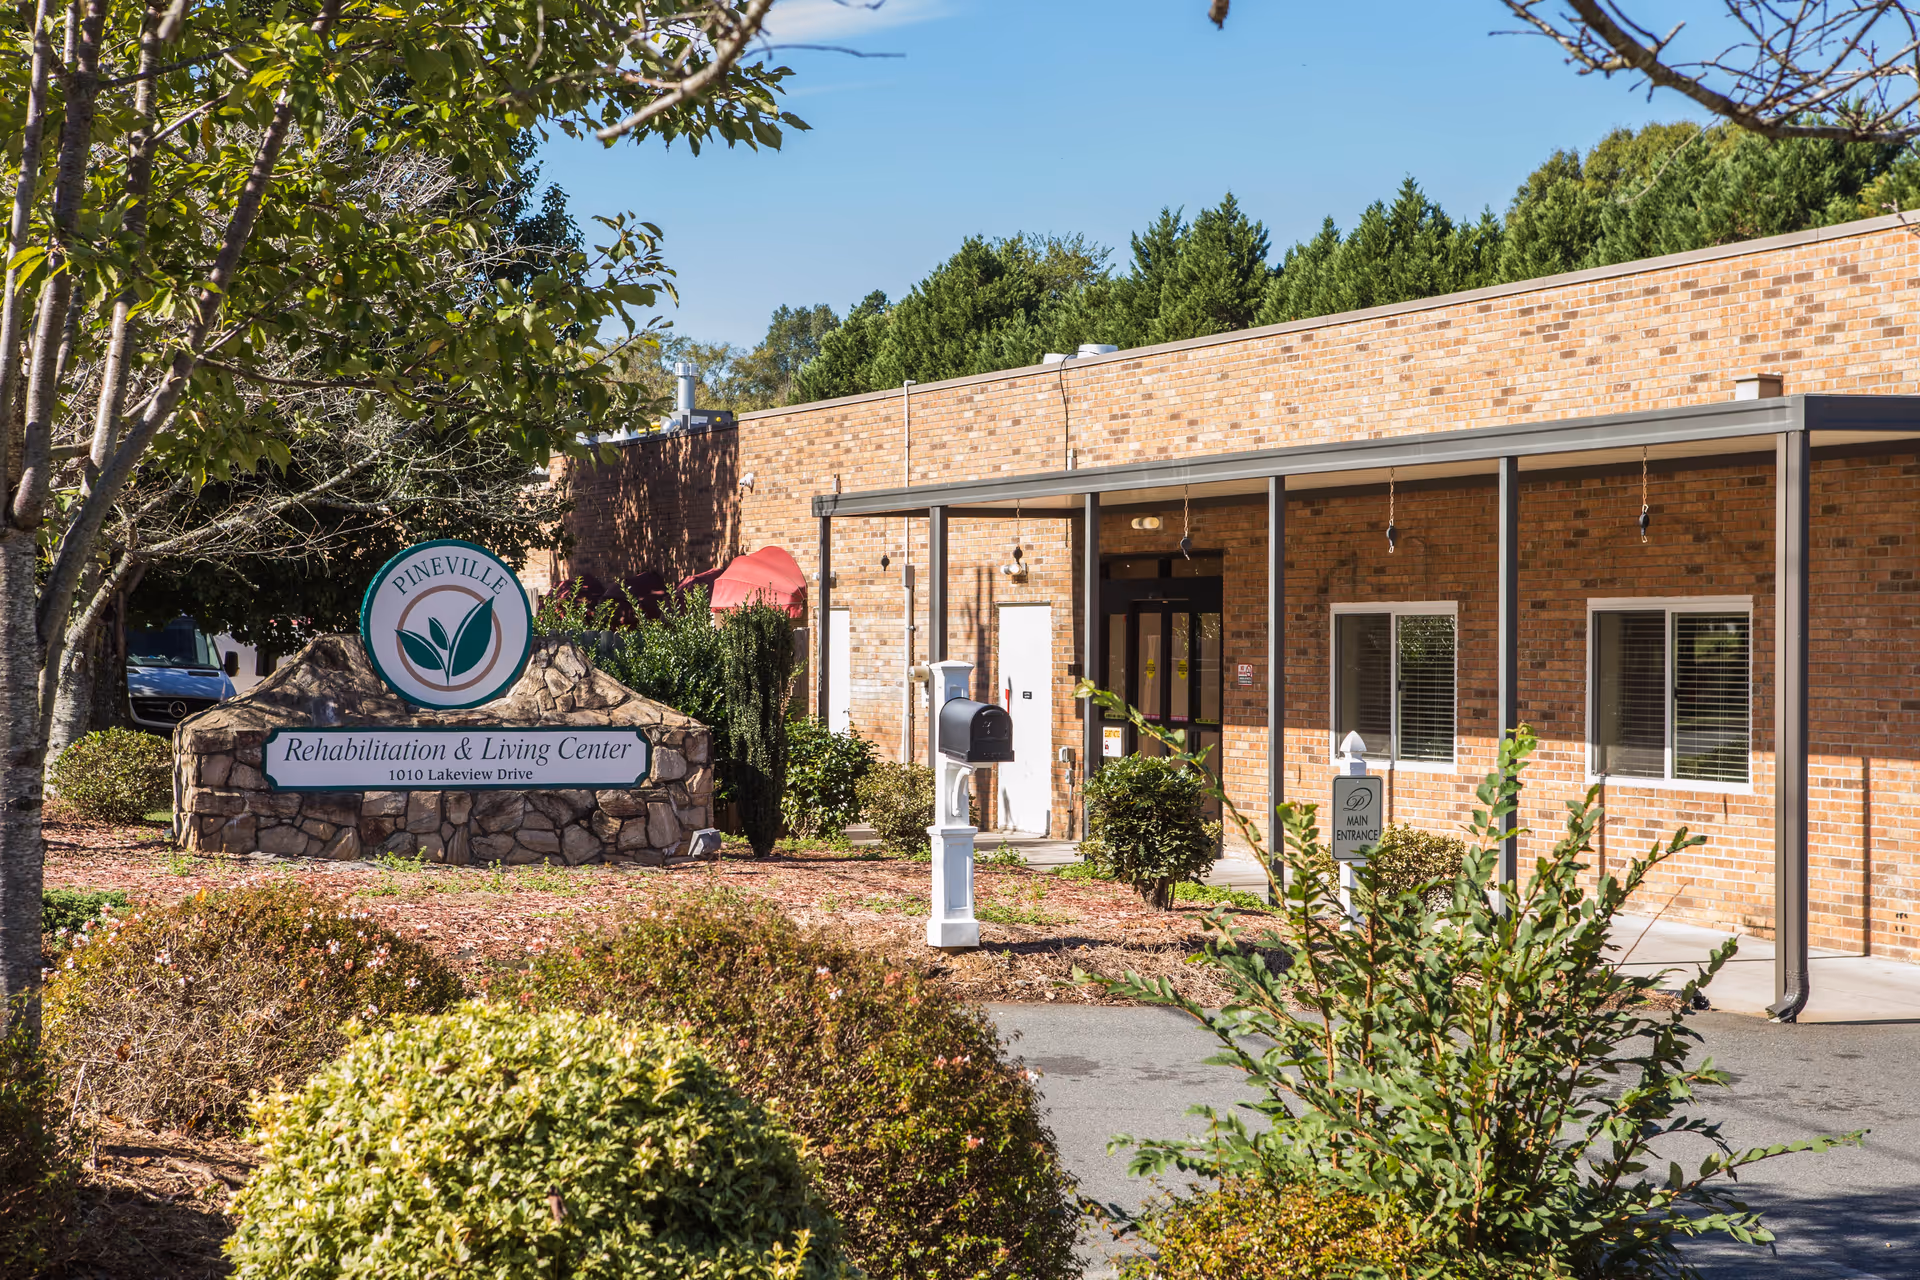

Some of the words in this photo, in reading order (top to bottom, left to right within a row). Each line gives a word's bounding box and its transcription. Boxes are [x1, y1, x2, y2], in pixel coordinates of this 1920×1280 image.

[392, 556, 508, 596] PINEVILLE
[283, 737, 447, 762] Rehabilitation
[454, 737, 473, 760] &
[481, 737, 551, 766] Living
[558, 737, 632, 760] Center
[389, 769, 424, 781] 1010
[428, 768, 493, 781] Lakeview
[497, 768, 533, 780] Drive
[1346, 815, 1368, 826] MAIN
[1336, 829, 1378, 841] ENTRANCE
